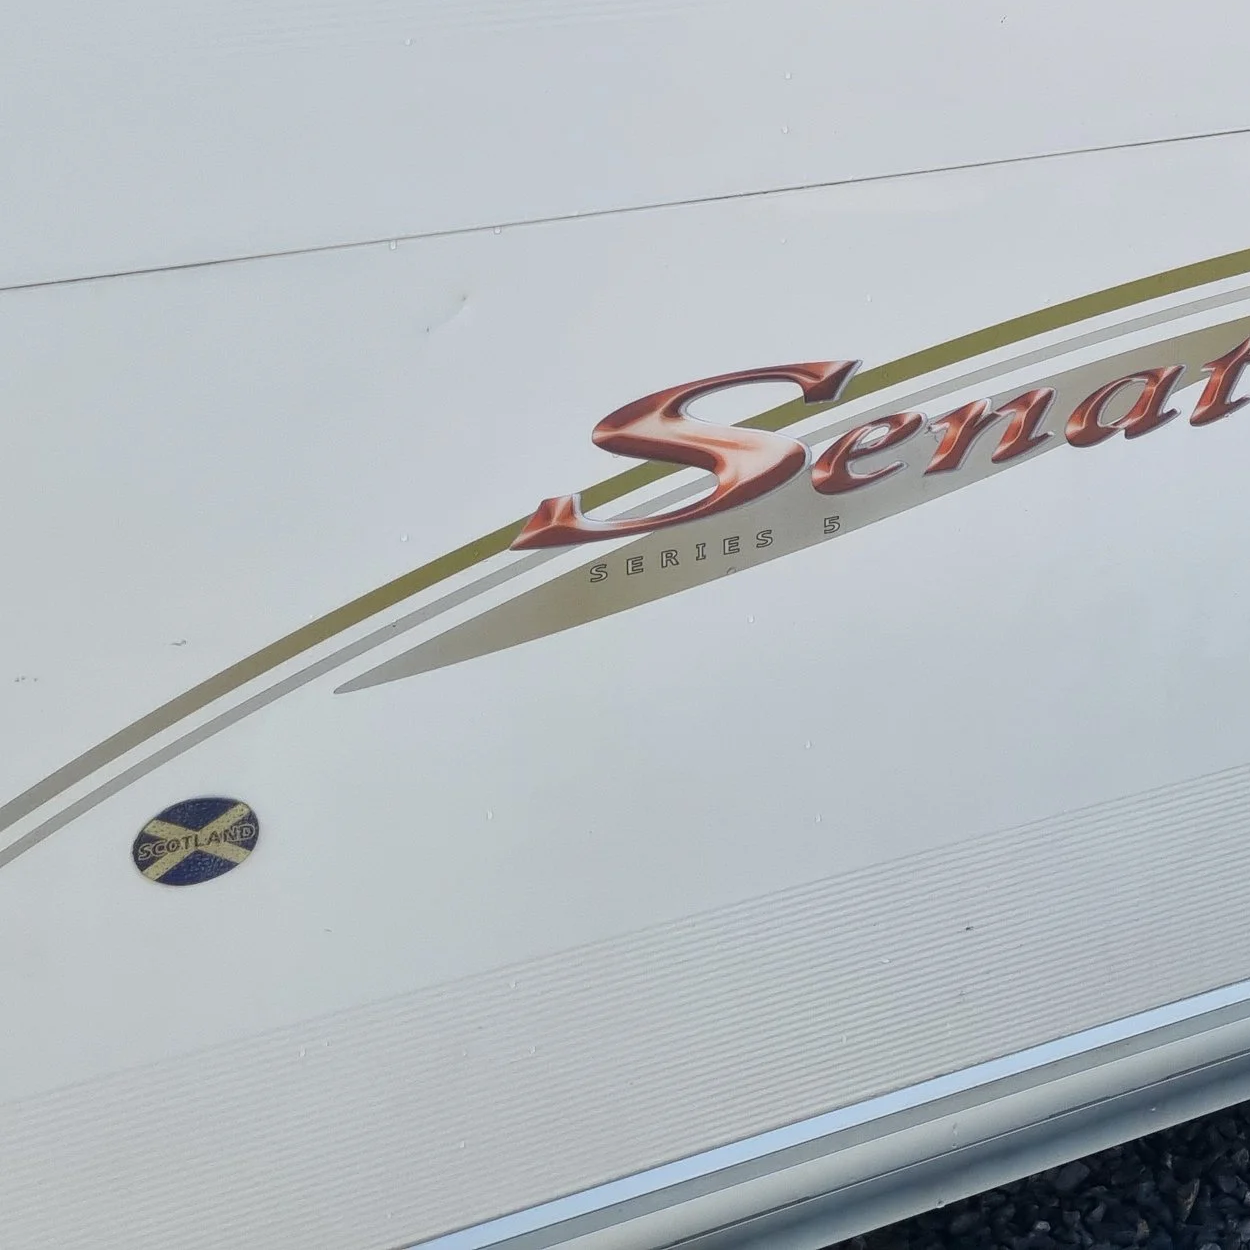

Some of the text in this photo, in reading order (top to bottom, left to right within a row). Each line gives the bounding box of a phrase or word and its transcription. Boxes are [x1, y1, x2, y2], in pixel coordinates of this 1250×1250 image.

[589, 516, 841, 583] SERIES 5
[137, 823, 256, 861] SCOTLAND
